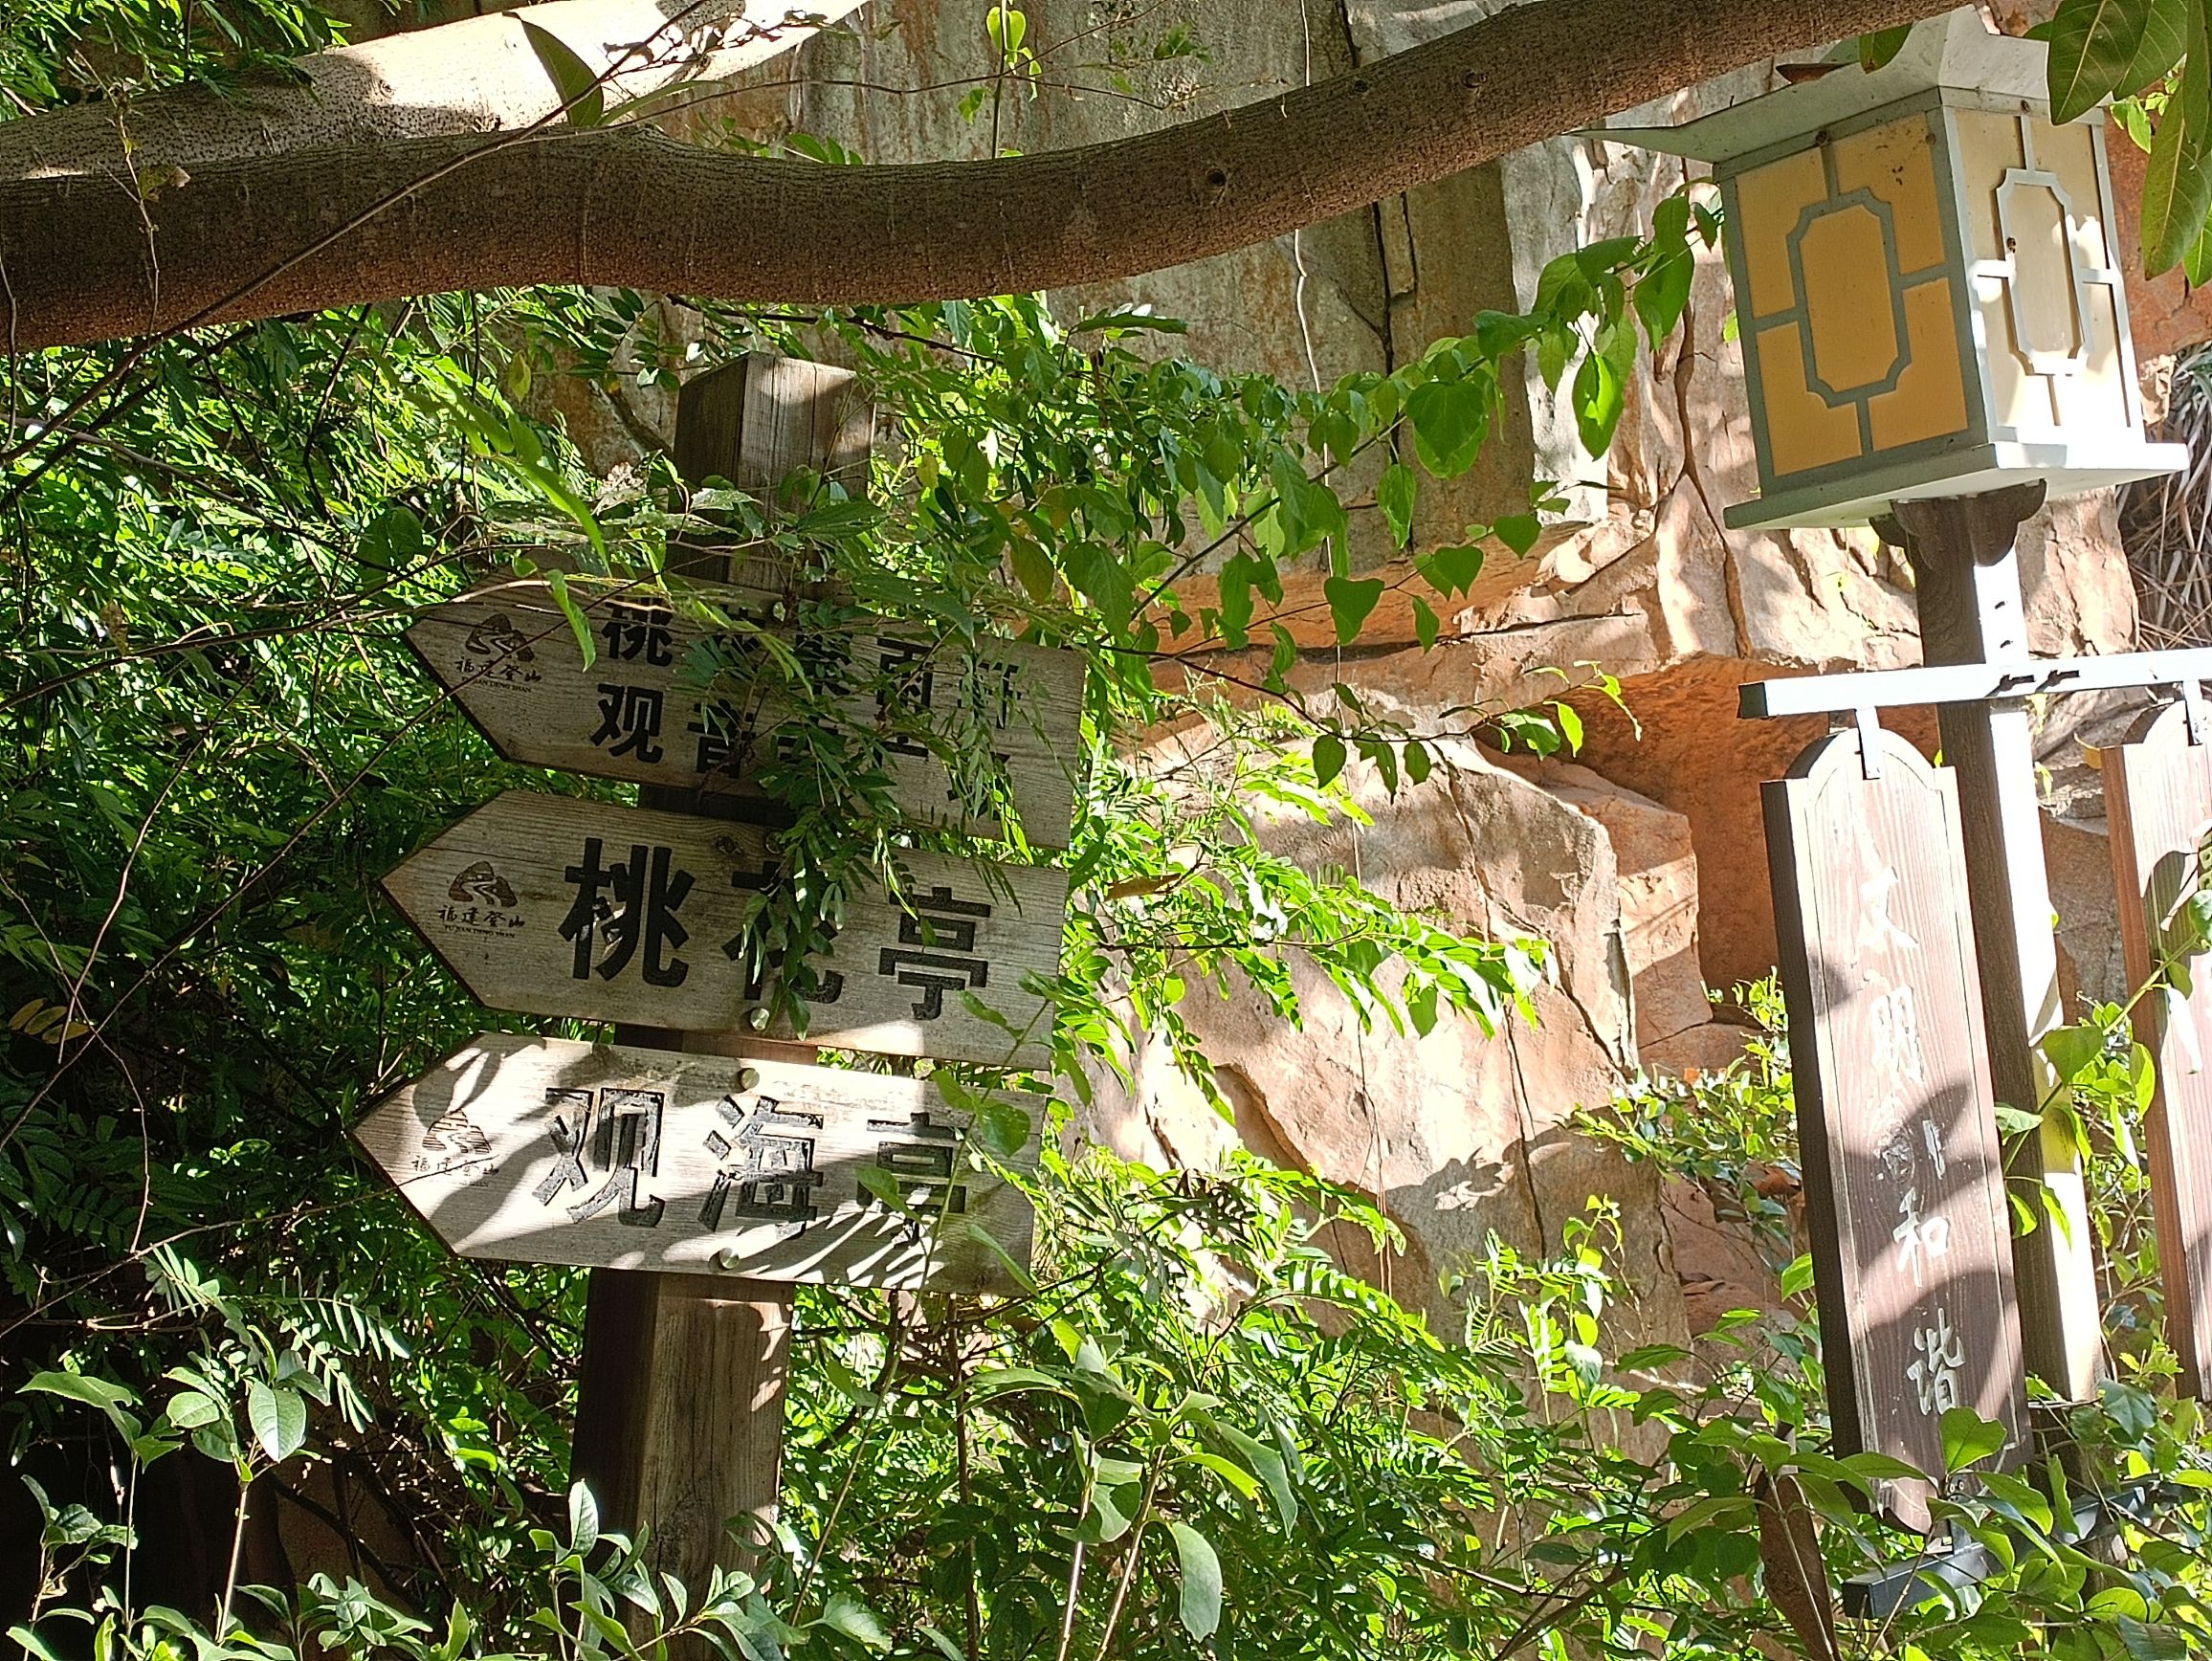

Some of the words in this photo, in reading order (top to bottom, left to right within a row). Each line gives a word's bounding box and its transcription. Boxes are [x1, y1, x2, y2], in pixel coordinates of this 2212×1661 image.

[437, 904, 525, 928] 福建登山
[532, 1087, 966, 1248] 观海亭
